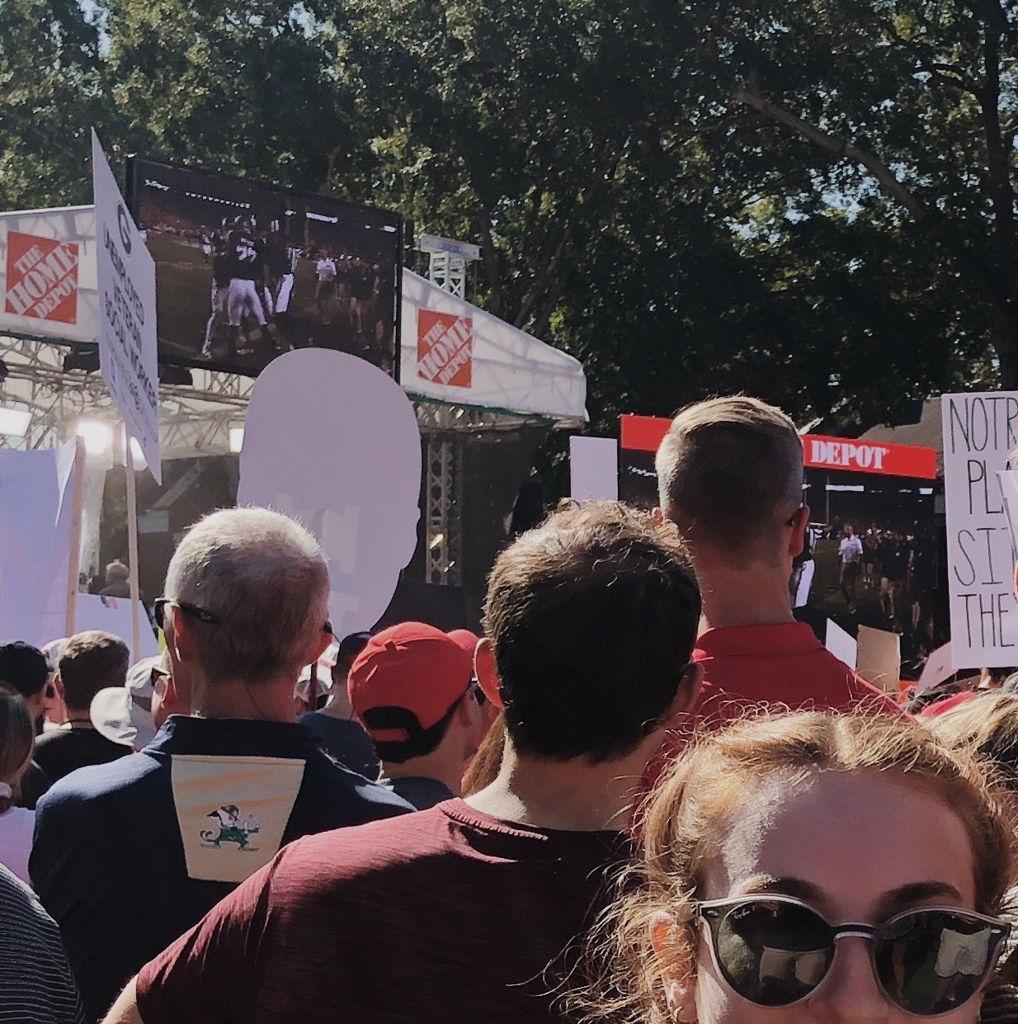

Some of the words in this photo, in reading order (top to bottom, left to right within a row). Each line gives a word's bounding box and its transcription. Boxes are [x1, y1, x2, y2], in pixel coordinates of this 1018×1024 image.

[6, 240, 79, 315] HOME
[417, 316, 473, 381] HOME
[811, 440, 887, 470] DEPOT
[967, 459, 1012, 515] PL
